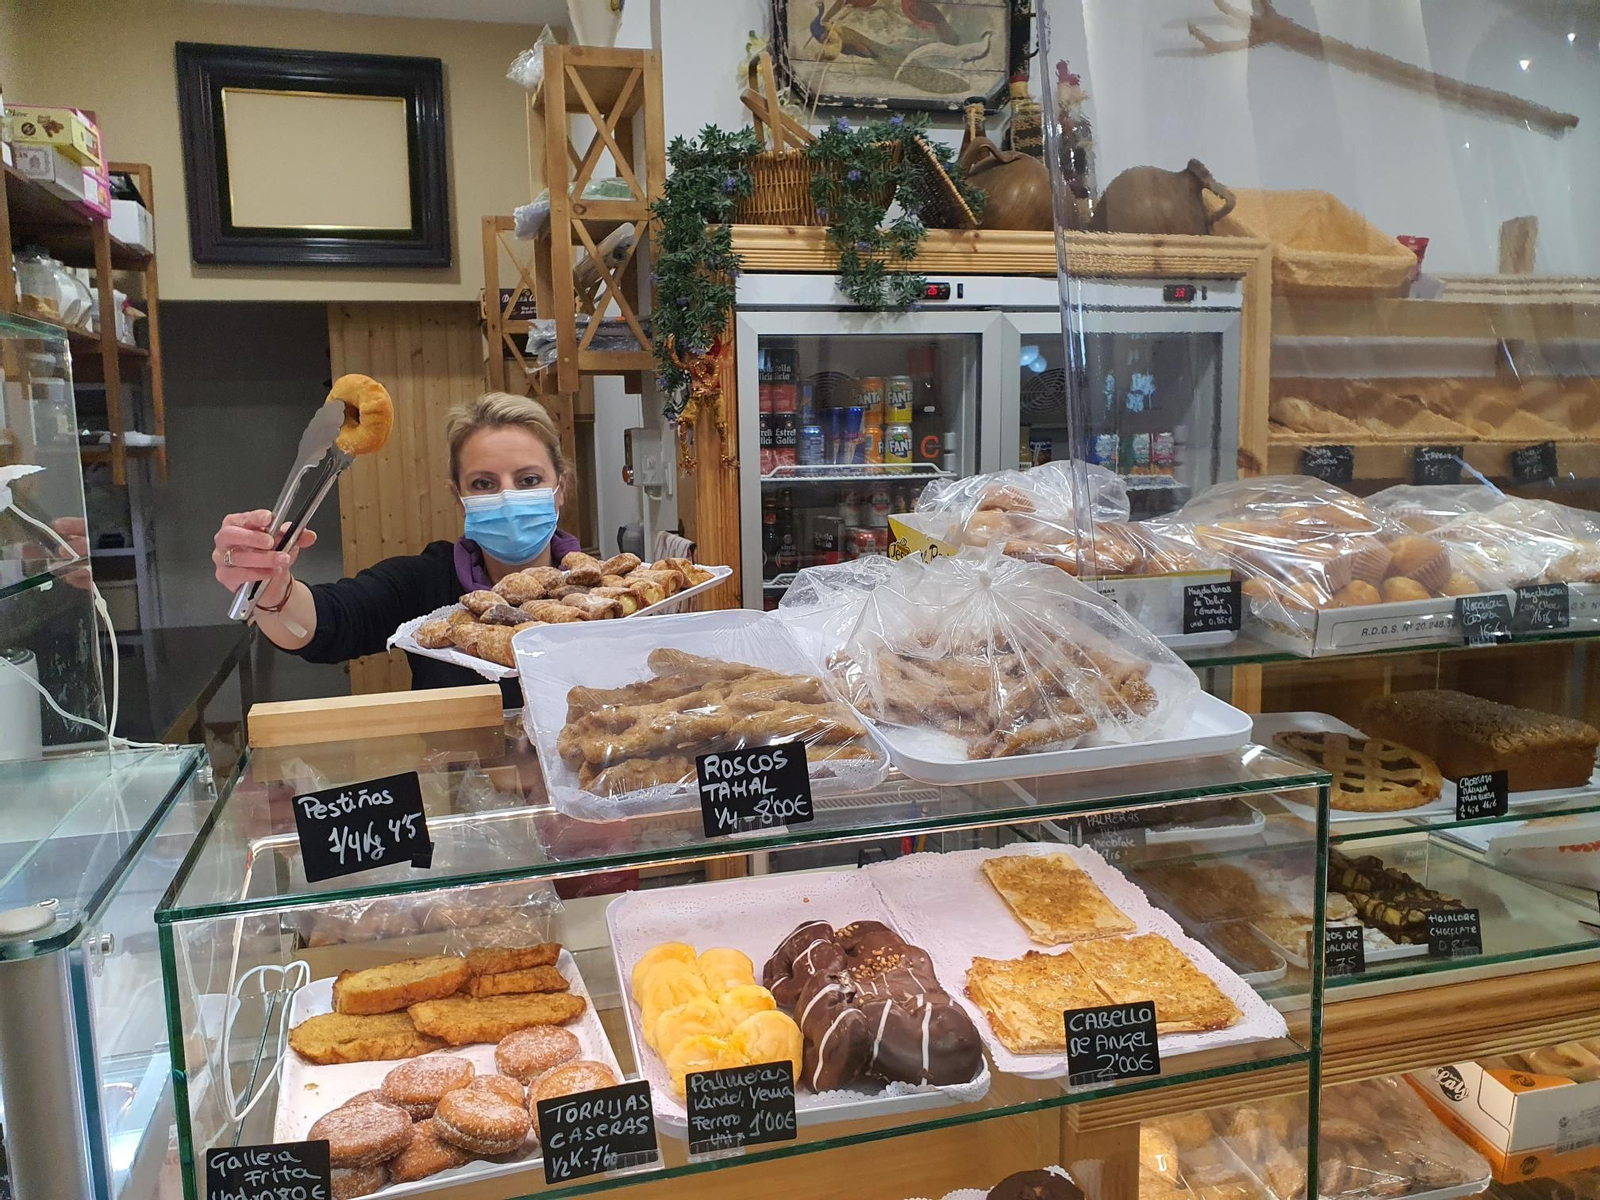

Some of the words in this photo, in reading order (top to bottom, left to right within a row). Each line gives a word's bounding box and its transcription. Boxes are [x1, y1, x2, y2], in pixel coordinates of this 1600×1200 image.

[704, 750, 789, 780] ROSCOS
[298, 788, 395, 820] Pestiños
[1069, 1007, 1153, 1033] CABELLO
[690, 1070, 791, 1093] Palmeras
[545, 1094, 651, 1124] TORRIJAS
[748, 1085, 795, 1110] Yema
[243, 1164, 322, 1187] Frita
